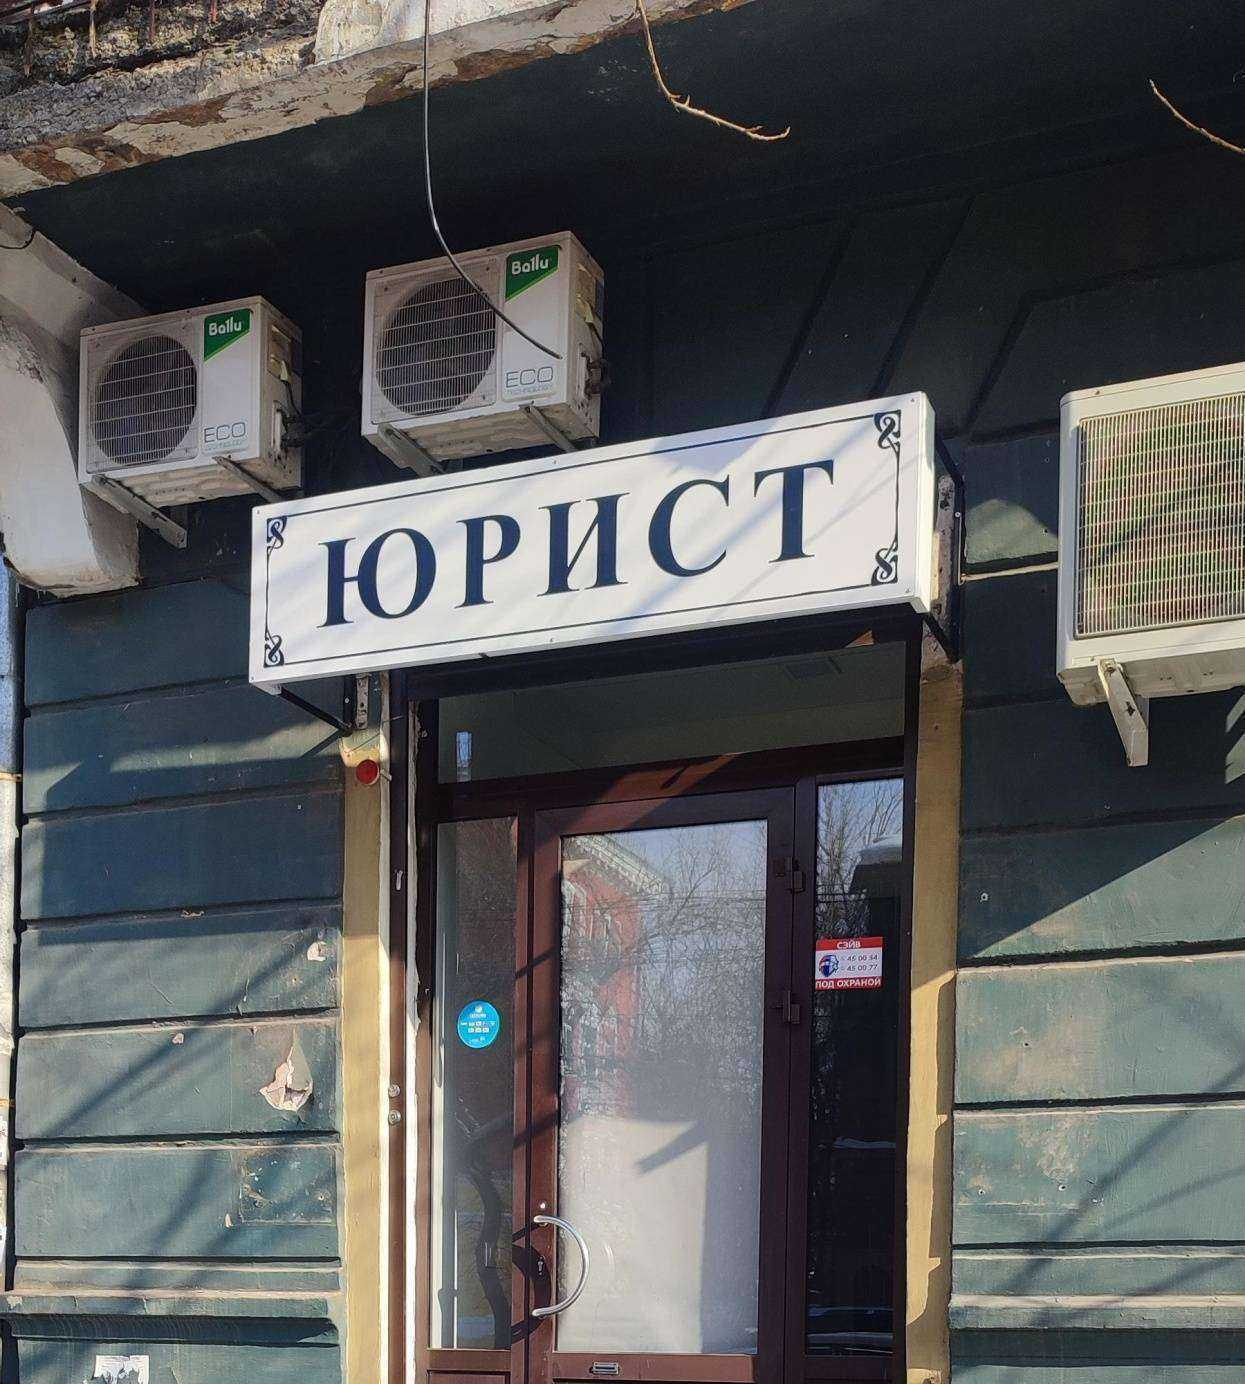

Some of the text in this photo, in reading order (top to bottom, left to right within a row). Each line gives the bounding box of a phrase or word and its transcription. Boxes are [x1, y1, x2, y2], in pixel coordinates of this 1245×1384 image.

[511, 253, 549, 275] Ballu
[208, 316, 242, 336] Ballu
[506, 366, 553, 388] ECO
[204, 421, 246, 443] ECO
[317, 459, 835, 628] ЮРИСТ
[836, 940, 861, 950] СЭЙВ
[847, 964, 856, 972] 45
[815, 976, 882, 989] ПОД ОХРАНОЙ
